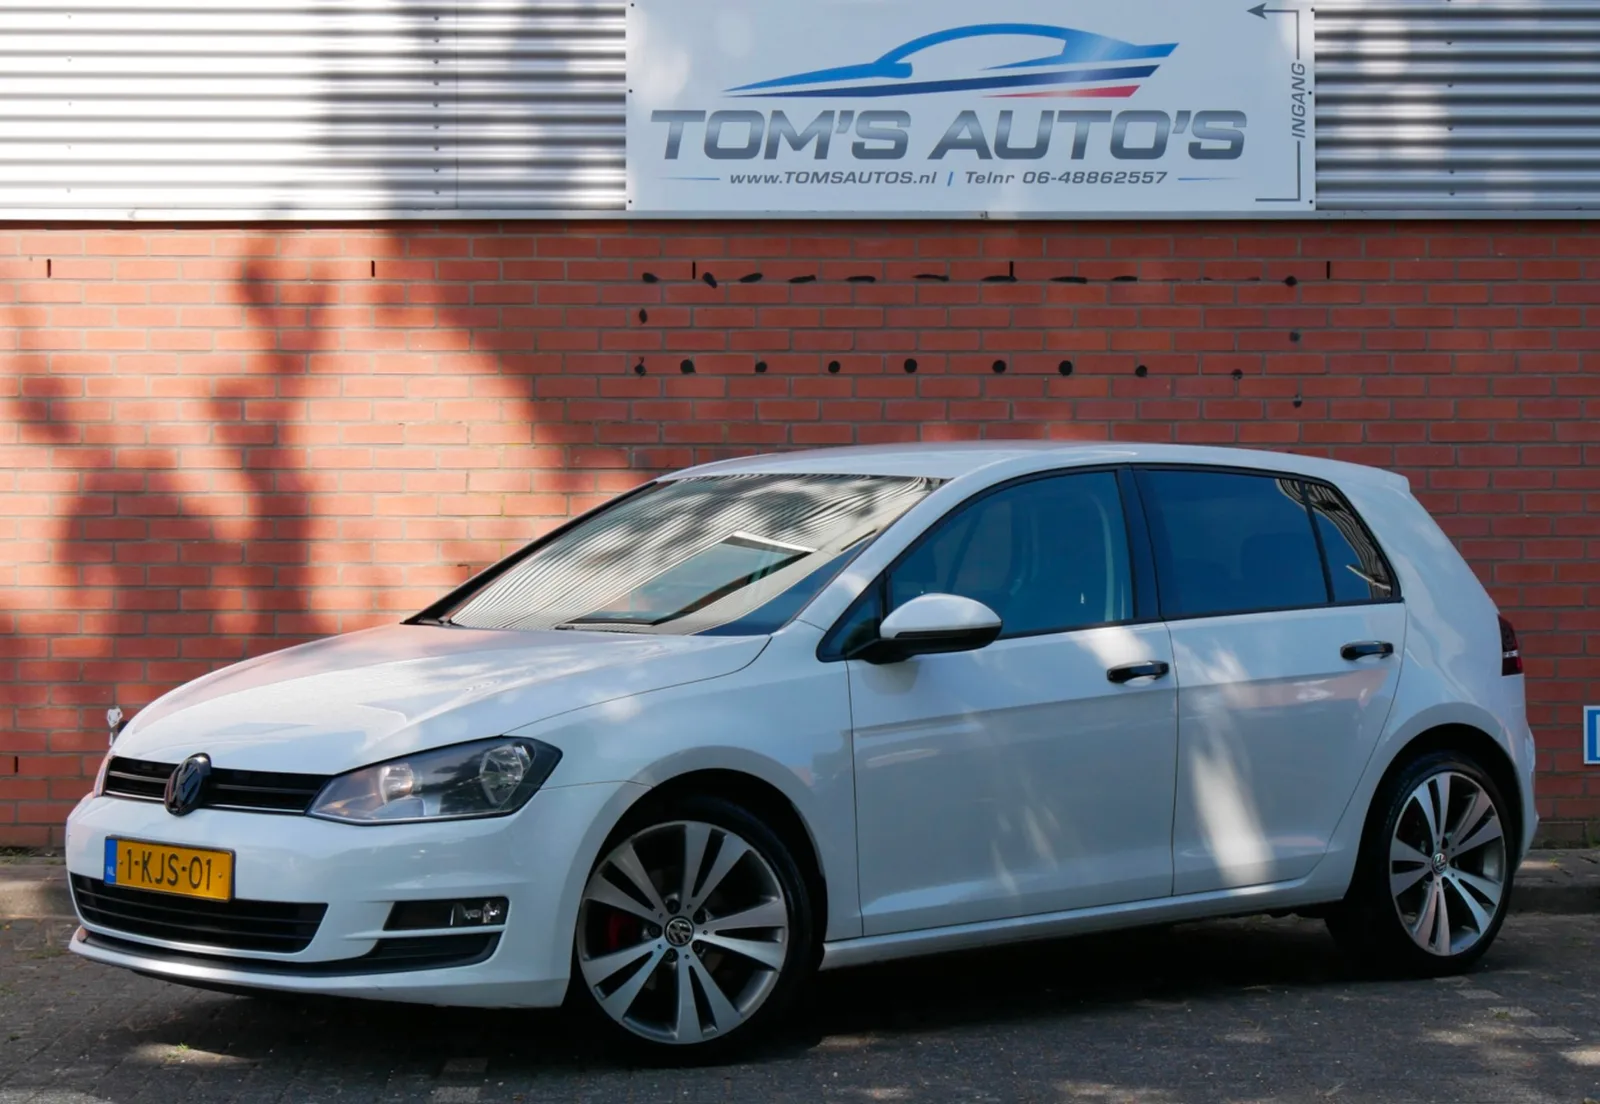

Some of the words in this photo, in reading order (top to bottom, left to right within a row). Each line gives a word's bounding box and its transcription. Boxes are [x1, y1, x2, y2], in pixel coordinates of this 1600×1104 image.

[1291, 62, 1306, 139] INGANG
[650, 109, 912, 160] TOM'S
[926, 109, 1248, 160] AUTO'S
[729, 170, 938, 185] www.TOMSAUTOS.nl
[965, 171, 1015, 184] Telnr
[1022, 170, 1168, 185] 06-48862557
[126, 848, 212, 891] 1-KJS-01
